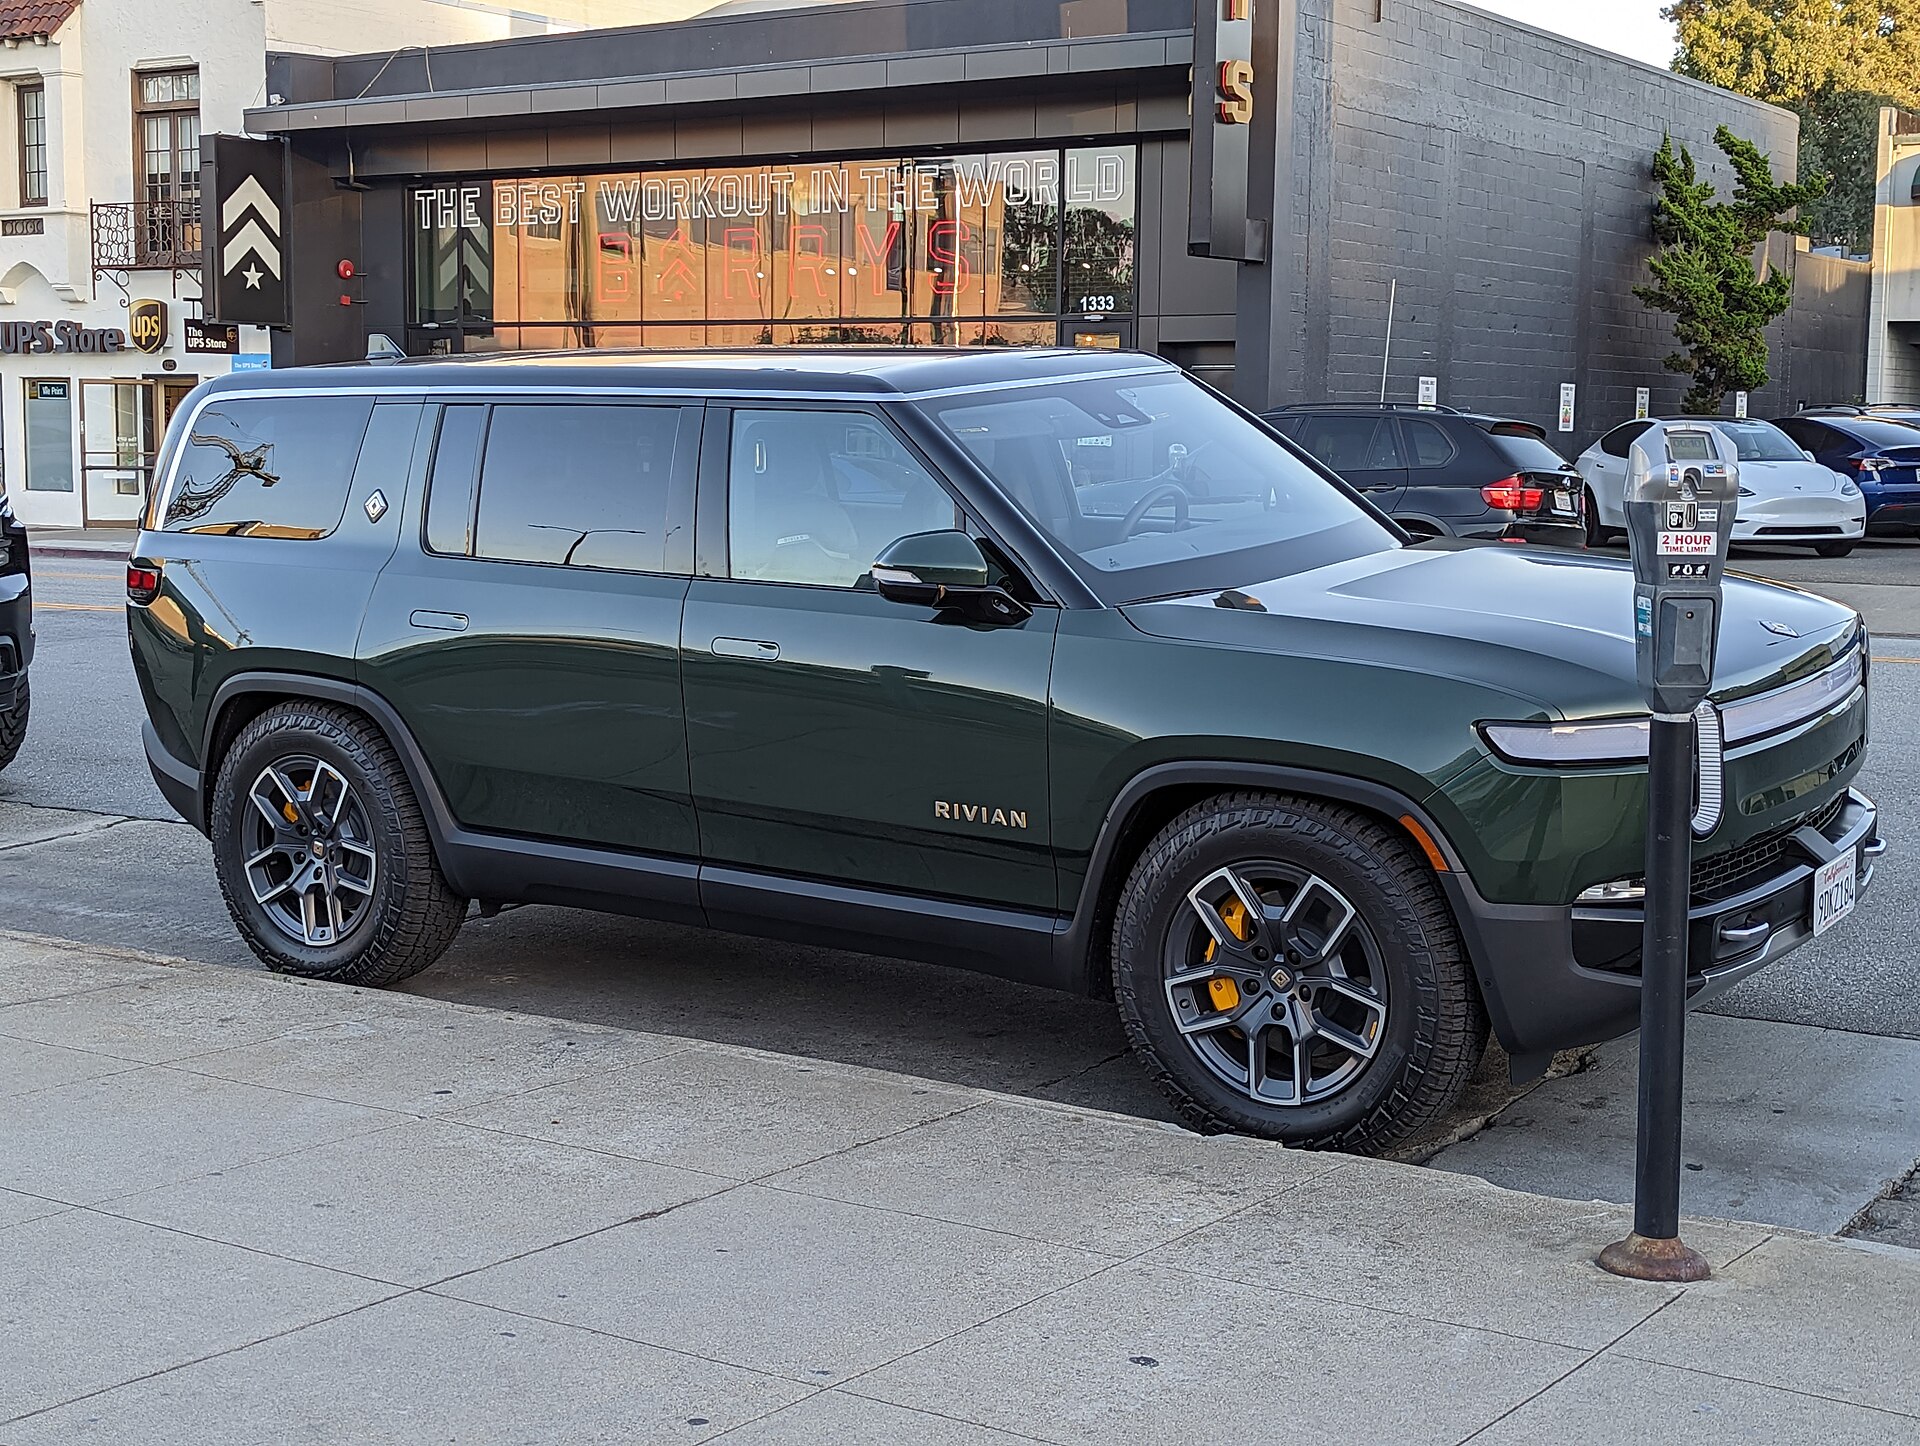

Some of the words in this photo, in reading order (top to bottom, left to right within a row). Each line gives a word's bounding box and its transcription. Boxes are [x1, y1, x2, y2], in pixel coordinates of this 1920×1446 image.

[414, 187, 481, 230] THE
[495, 182, 585, 228] BEST
[600, 172, 795, 223] WORKOUT
[811, 169, 849, 215] IN
[859, 165, 940, 212] THE
[953, 154, 1125, 208] WORLD
[1080, 295, 1115, 311] 1333
[0, 321, 54, 354] UPS
[55, 320, 122, 353] Store
[132, 315, 159, 345] ups
[187, 326, 203, 337] The
[187, 338, 205, 348] UPS
[205, 338, 227, 349] Store
[1662, 534, 1672, 545] 2
[1674, 534, 1712, 546] HOUR
[1686, 546, 1708, 554] LIMIT
[934, 800, 1028, 829] RIVIAN
[1818, 873, 1855, 926] 9DKZ184
